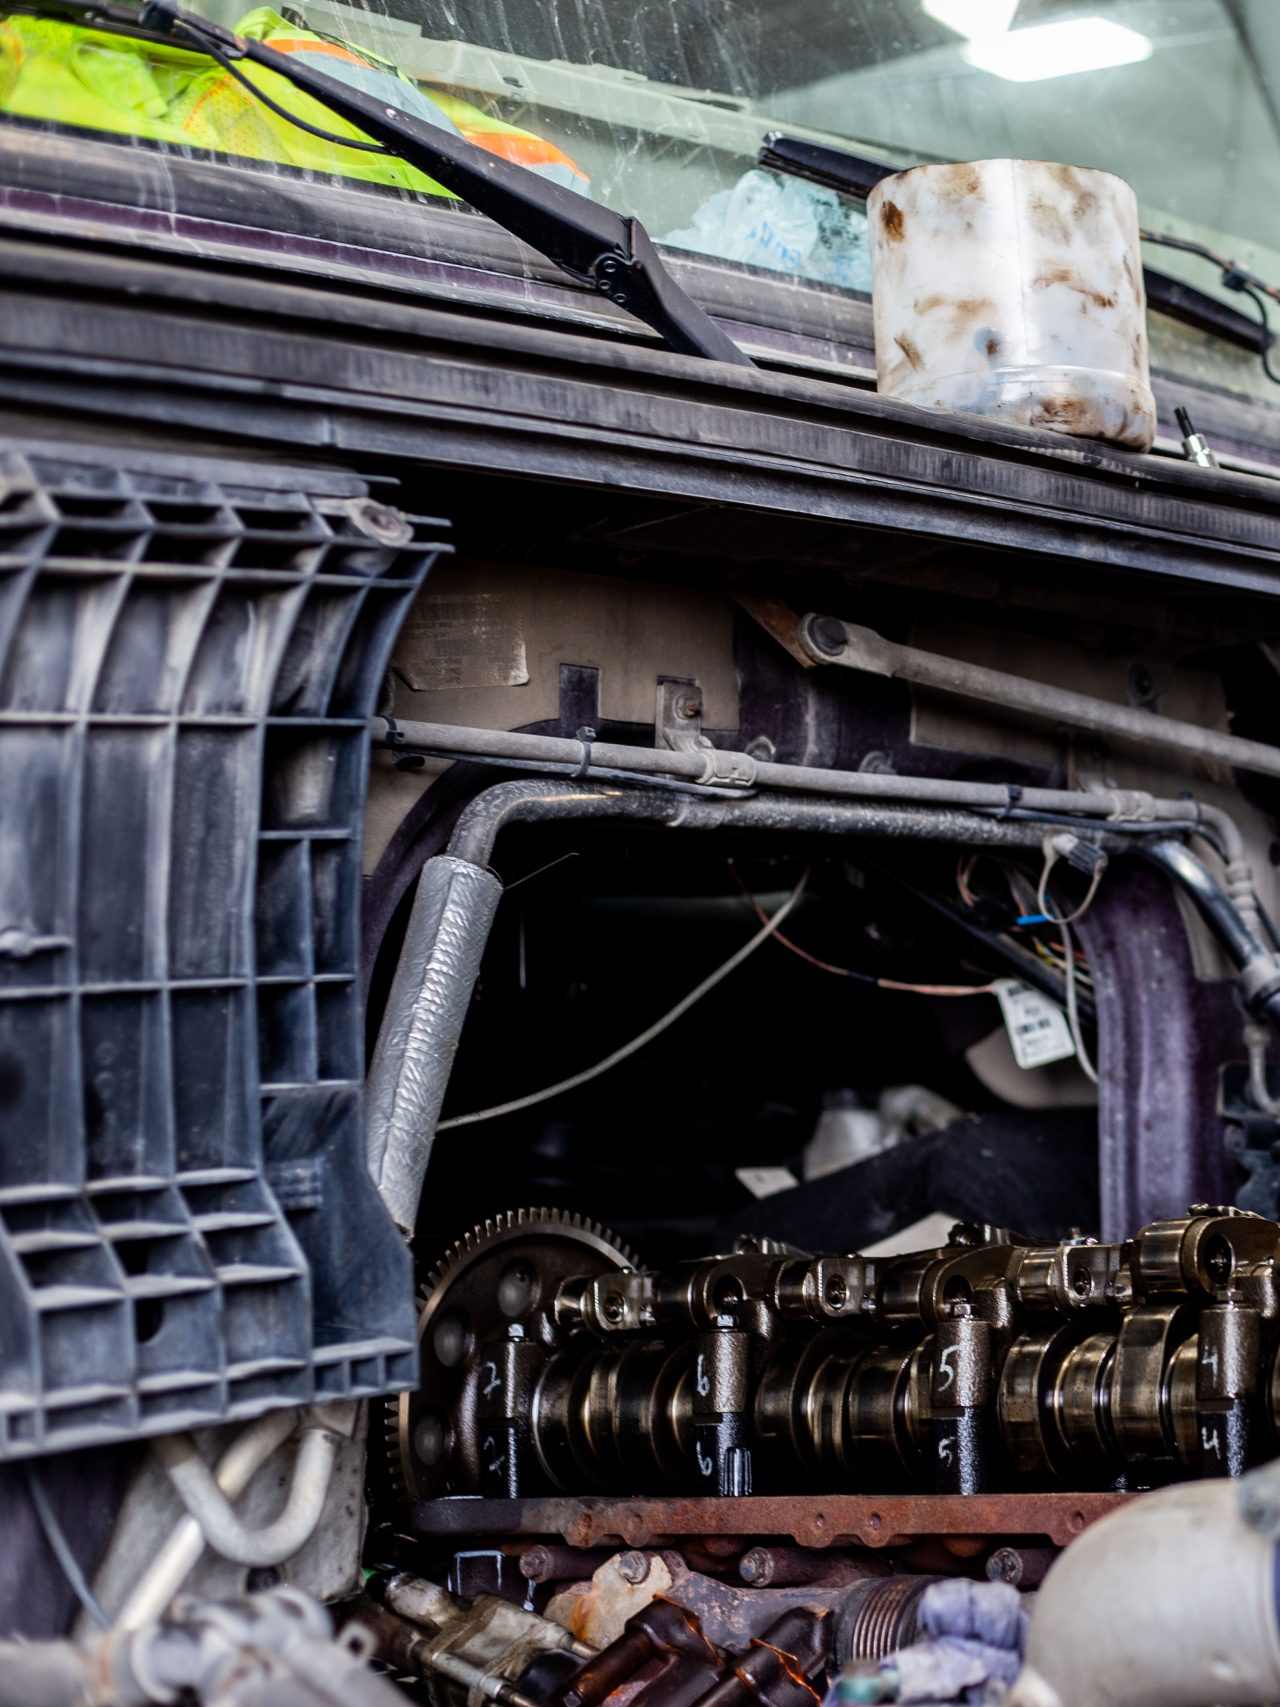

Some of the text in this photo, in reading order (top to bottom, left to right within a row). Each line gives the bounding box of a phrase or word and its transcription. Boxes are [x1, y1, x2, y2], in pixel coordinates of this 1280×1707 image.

[697, 1353, 710, 1397] 6
[938, 1344, 961, 1392] 5
[696, 1440, 713, 1477] 6
[938, 1436, 956, 1468] 5
[1201, 1426, 1221, 1460] 4
